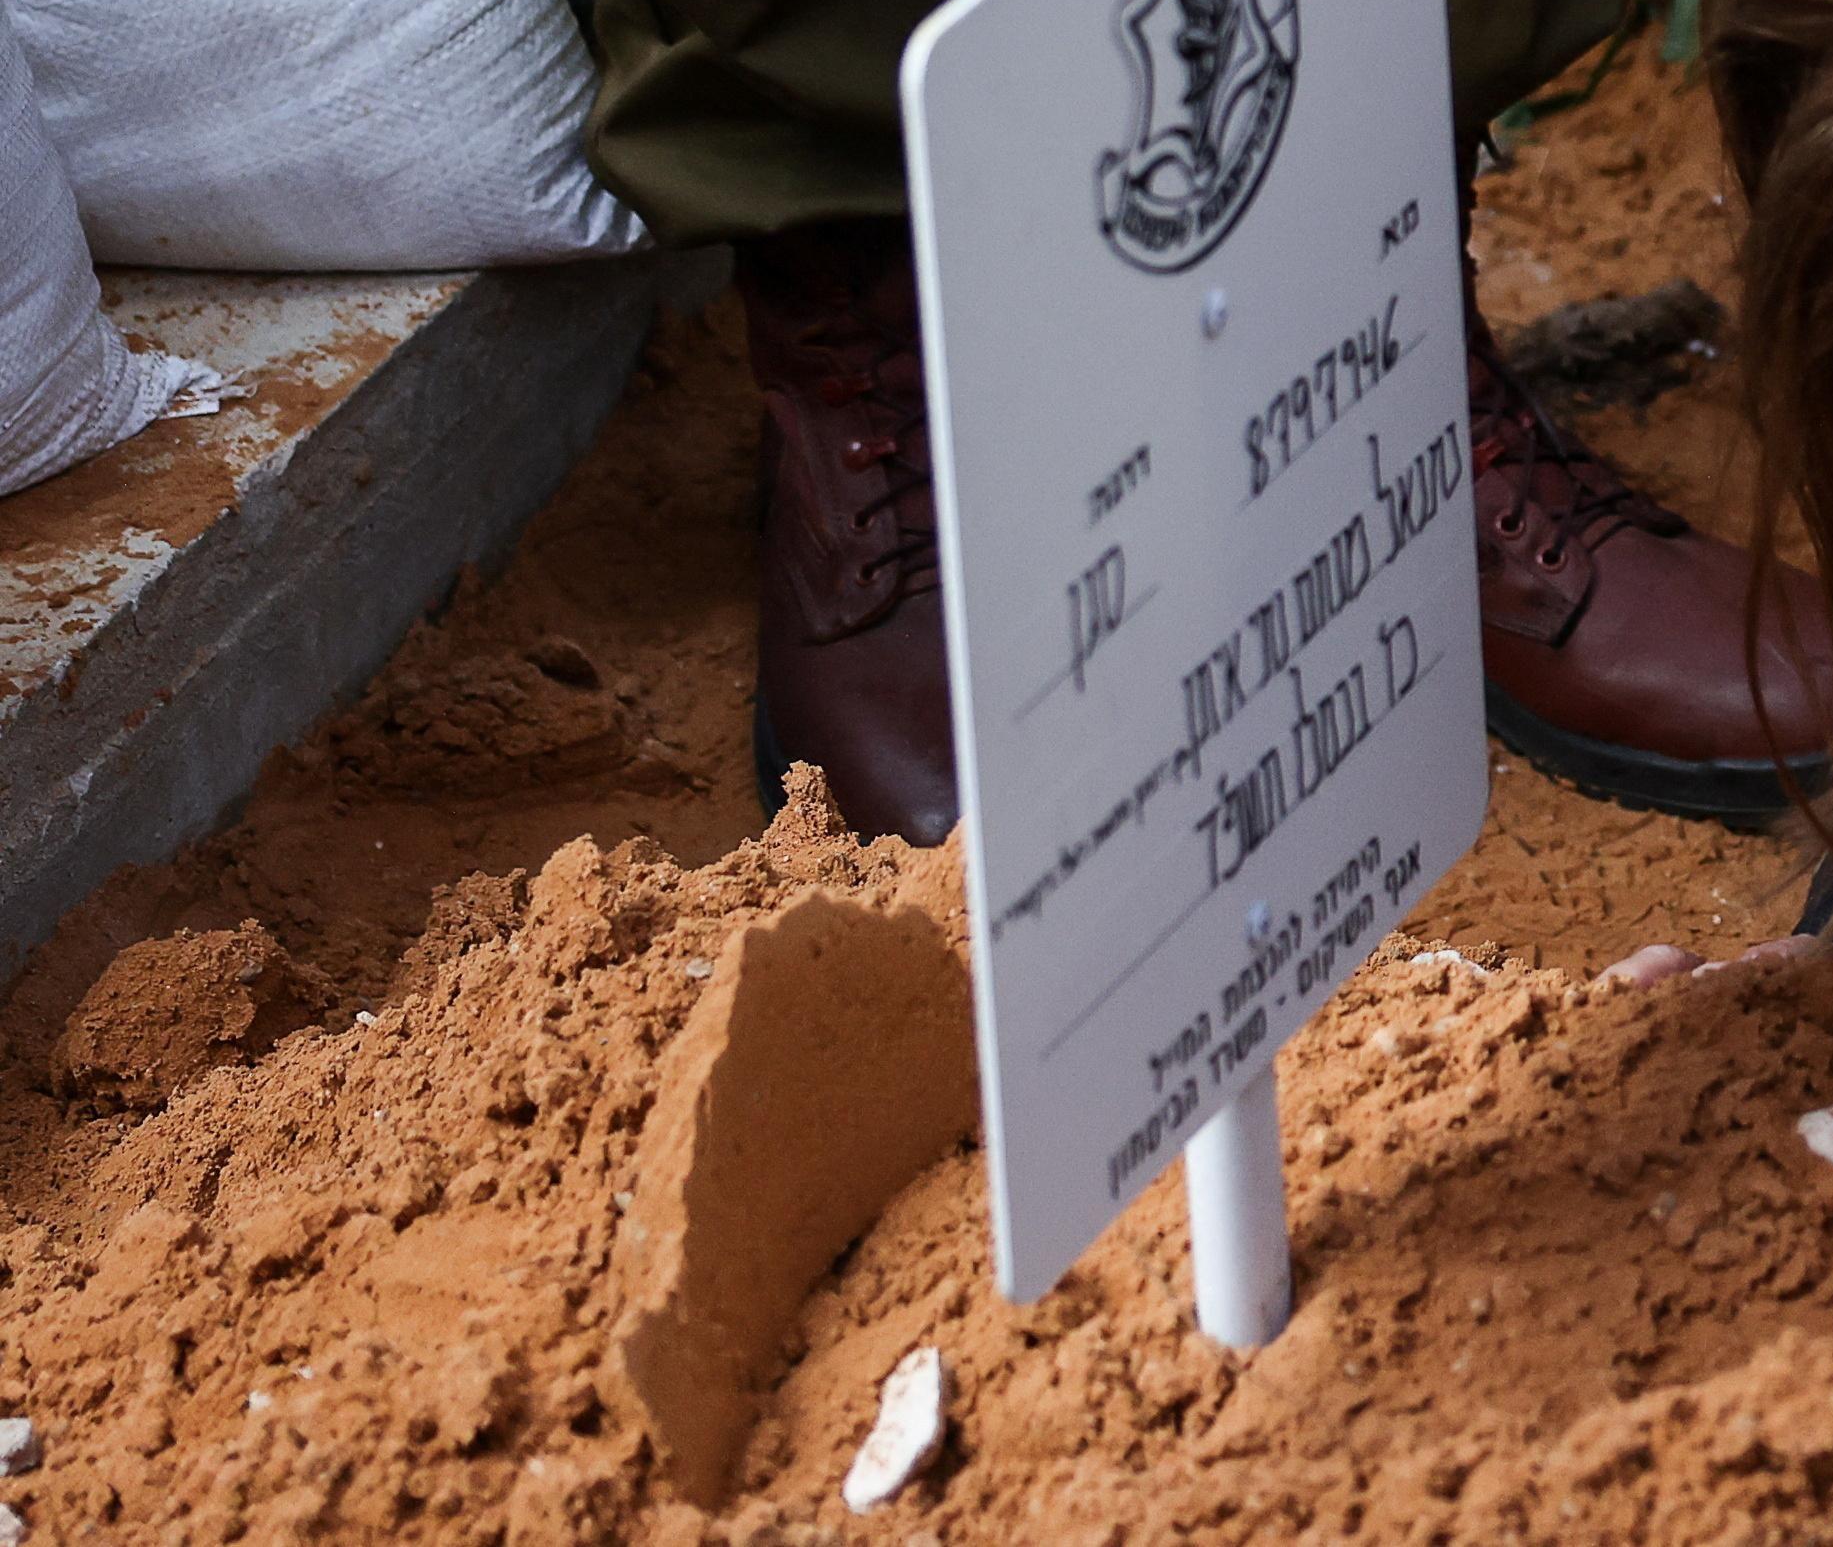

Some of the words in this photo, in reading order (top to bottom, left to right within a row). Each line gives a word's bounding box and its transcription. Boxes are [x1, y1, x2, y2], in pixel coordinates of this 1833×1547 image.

[1244, 294, 1400, 499] 8797946
[1366, 420, 1463, 574] נתנאל
[1292, 512, 1372, 649] מנחם
[1312, 836, 1382, 930] היחידה
[1383, 841, 1421, 907] אגף
[1220, 911, 1303, 1025] להנצחת
[1296, 893, 1375, 999] השיקום
[1206, 1005, 1268, 1085] משרד
